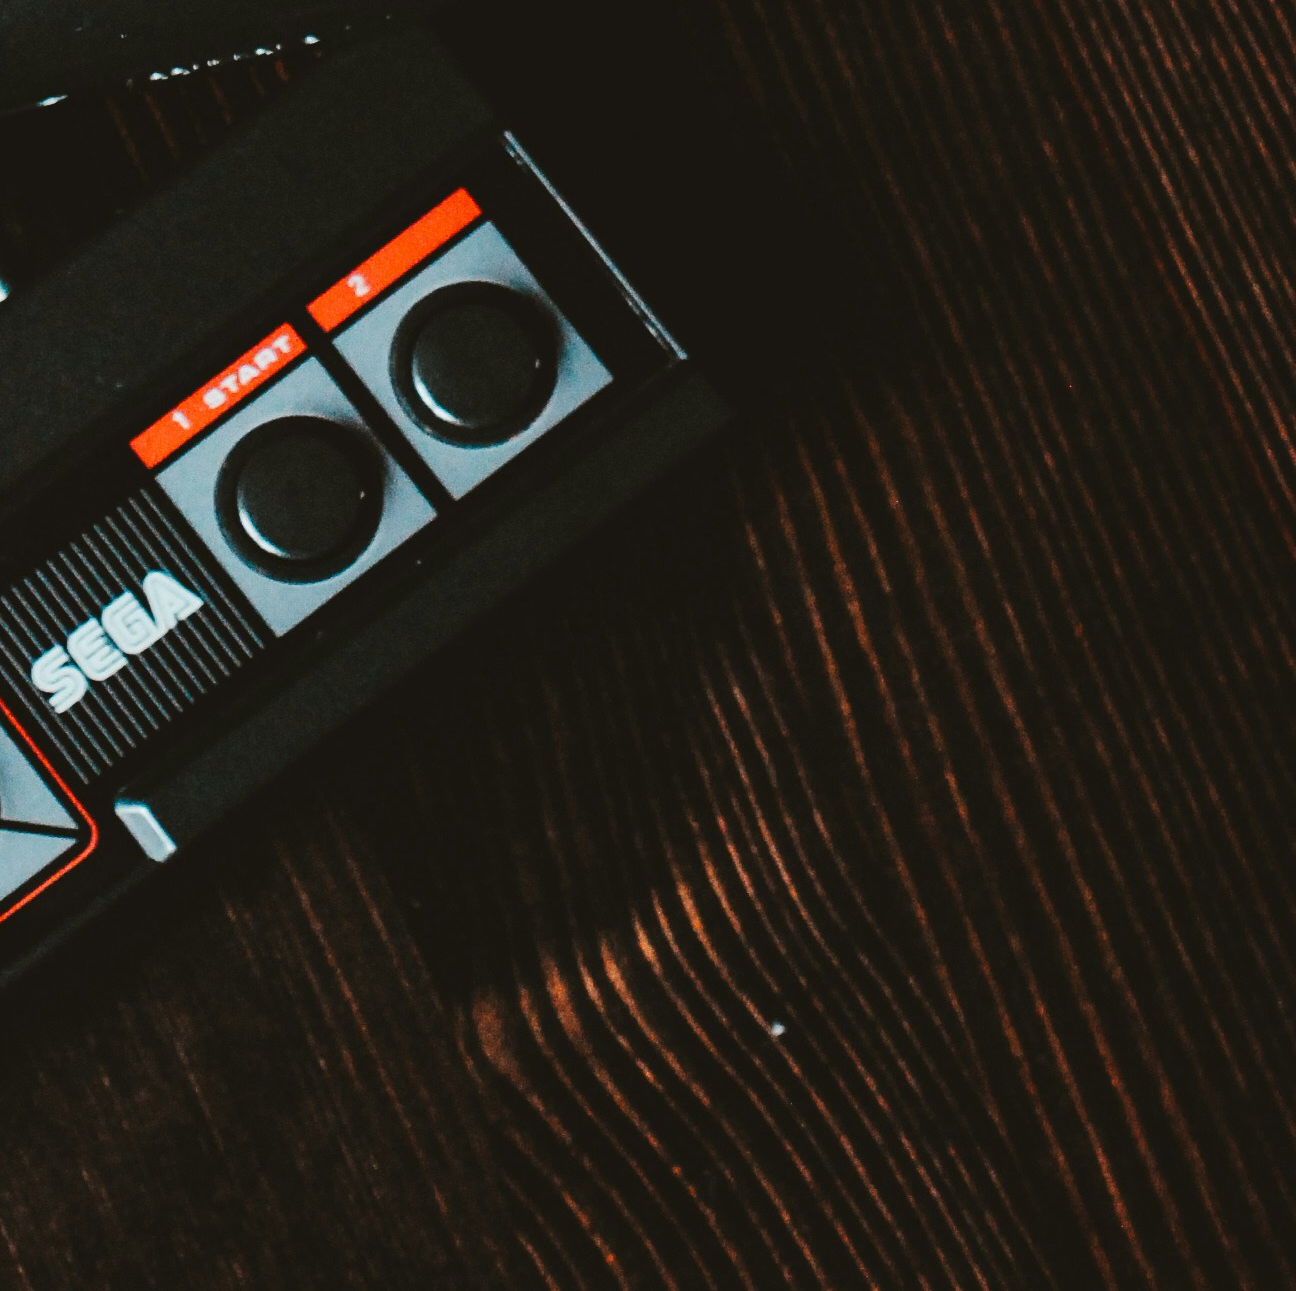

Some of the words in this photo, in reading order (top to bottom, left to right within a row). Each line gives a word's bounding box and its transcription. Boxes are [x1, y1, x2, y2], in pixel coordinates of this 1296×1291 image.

[347, 273, 371, 298] 2
[172, 410, 192, 431] 1
[202, 333, 292, 411] START
[31, 570, 205, 714] SEGA
